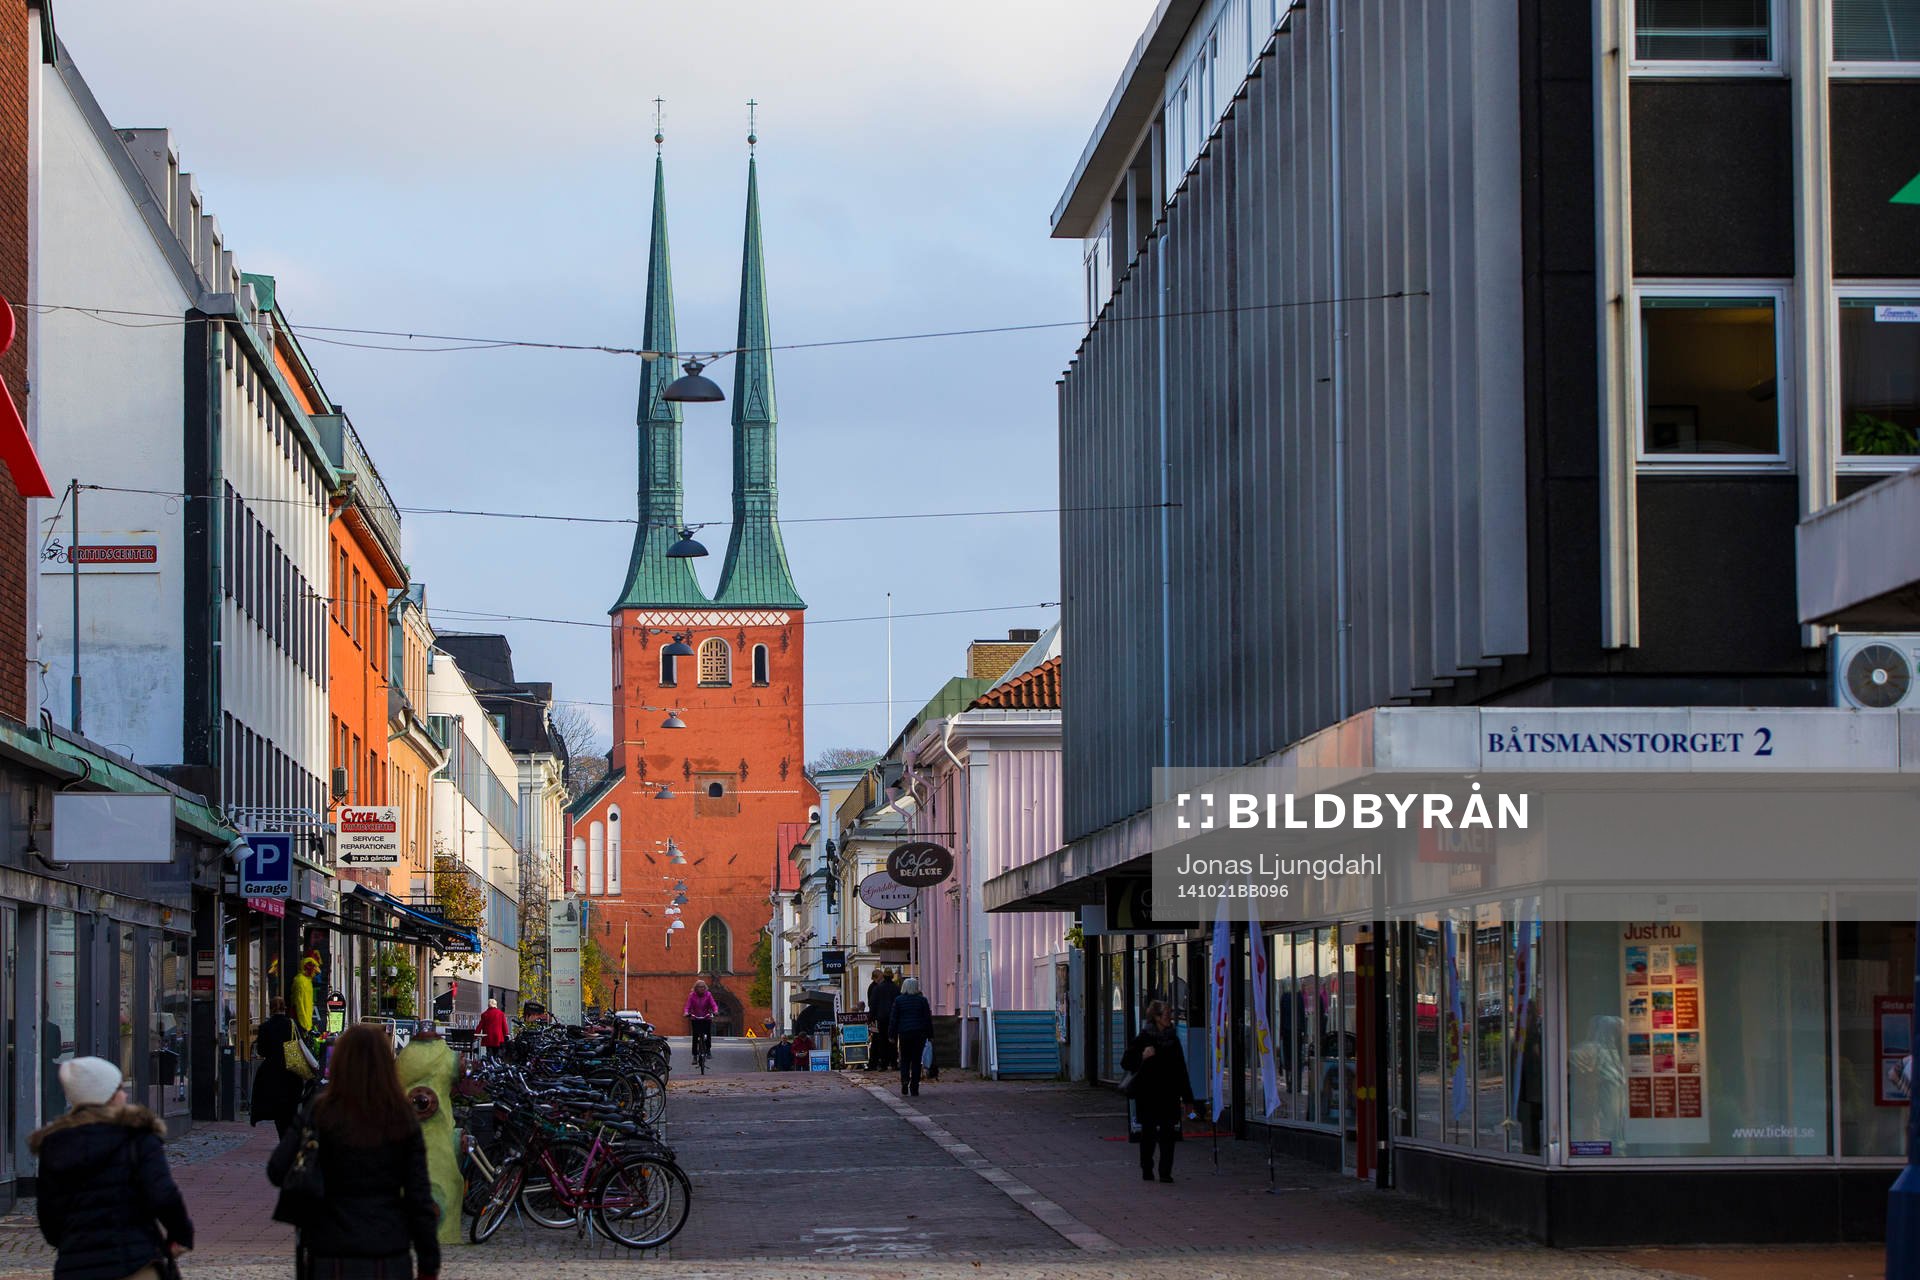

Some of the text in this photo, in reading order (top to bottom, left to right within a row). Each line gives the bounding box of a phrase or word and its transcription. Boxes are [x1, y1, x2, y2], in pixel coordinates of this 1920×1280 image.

[72, 549, 153, 559] RITIDSCENTER
[1488, 726, 1773, 756] BÅTSMANSTORGET 2
[341, 808, 380, 822] CYKEL
[257, 844, 280, 874] P
[900, 868, 943, 877] DE LUXE
[245, 883, 288, 896] Garage
[1624, 923, 1681, 940] Just nu
[1732, 1125, 1816, 1139] www.ticket.se
